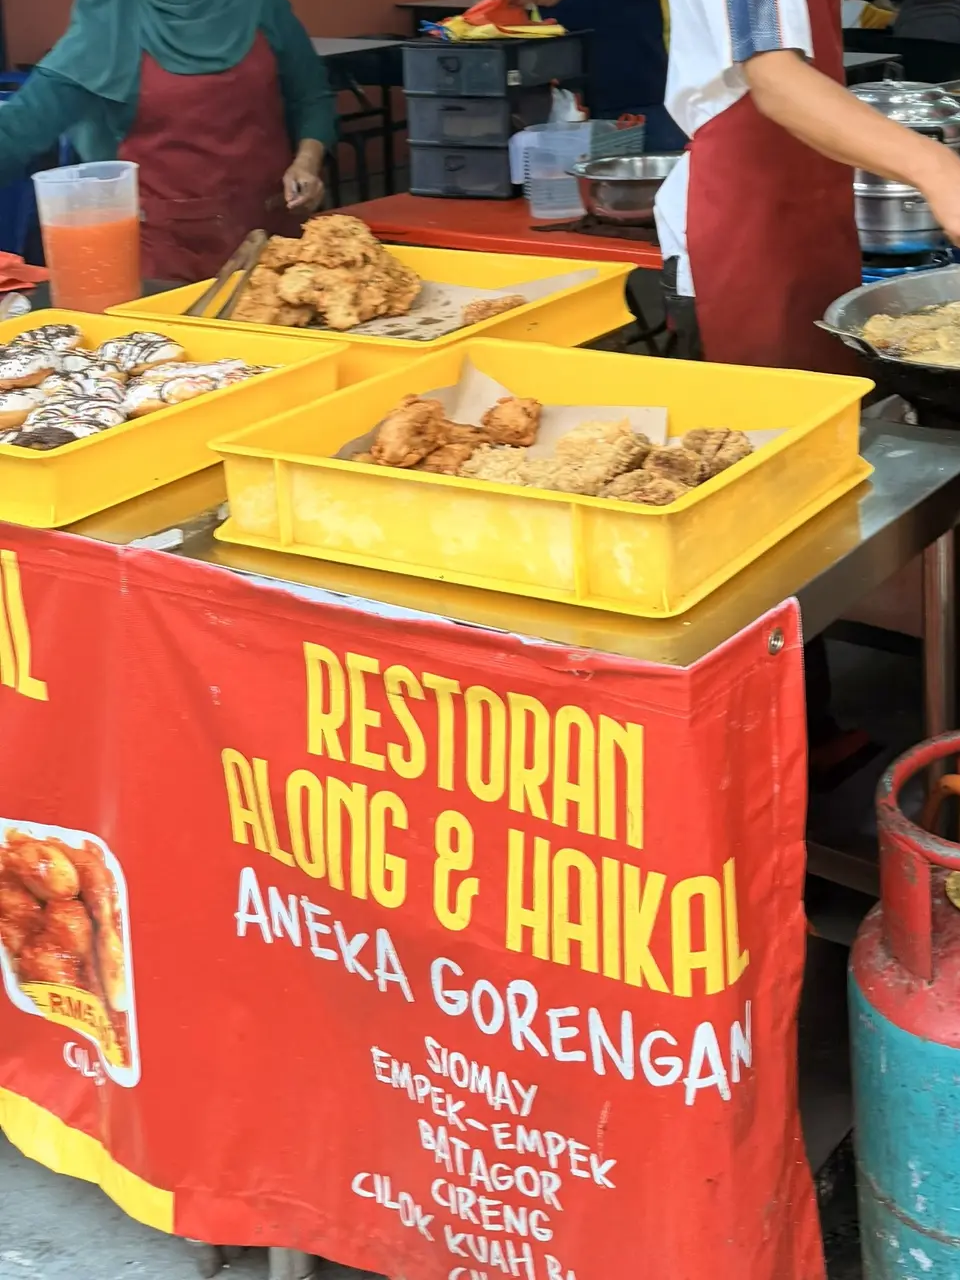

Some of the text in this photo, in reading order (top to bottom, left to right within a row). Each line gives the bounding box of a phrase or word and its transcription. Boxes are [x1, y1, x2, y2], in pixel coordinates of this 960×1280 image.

[303, 641, 645, 850] RESTORAN
[221, 748, 749, 998] ALONG & HAIKAL
[234, 866, 753, 1107] ANEKA GORENGAN
[370, 1045, 617, 1189] EMPEK-EMPEK
[424, 1035, 538, 1117] SIOMAY
[351, 1172, 435, 1242] CILOK
[443, 1224, 536, 1280] KUAH
[417, 1118, 564, 1211] BATAGOR
[430, 1178, 554, 1242] CIRENG
